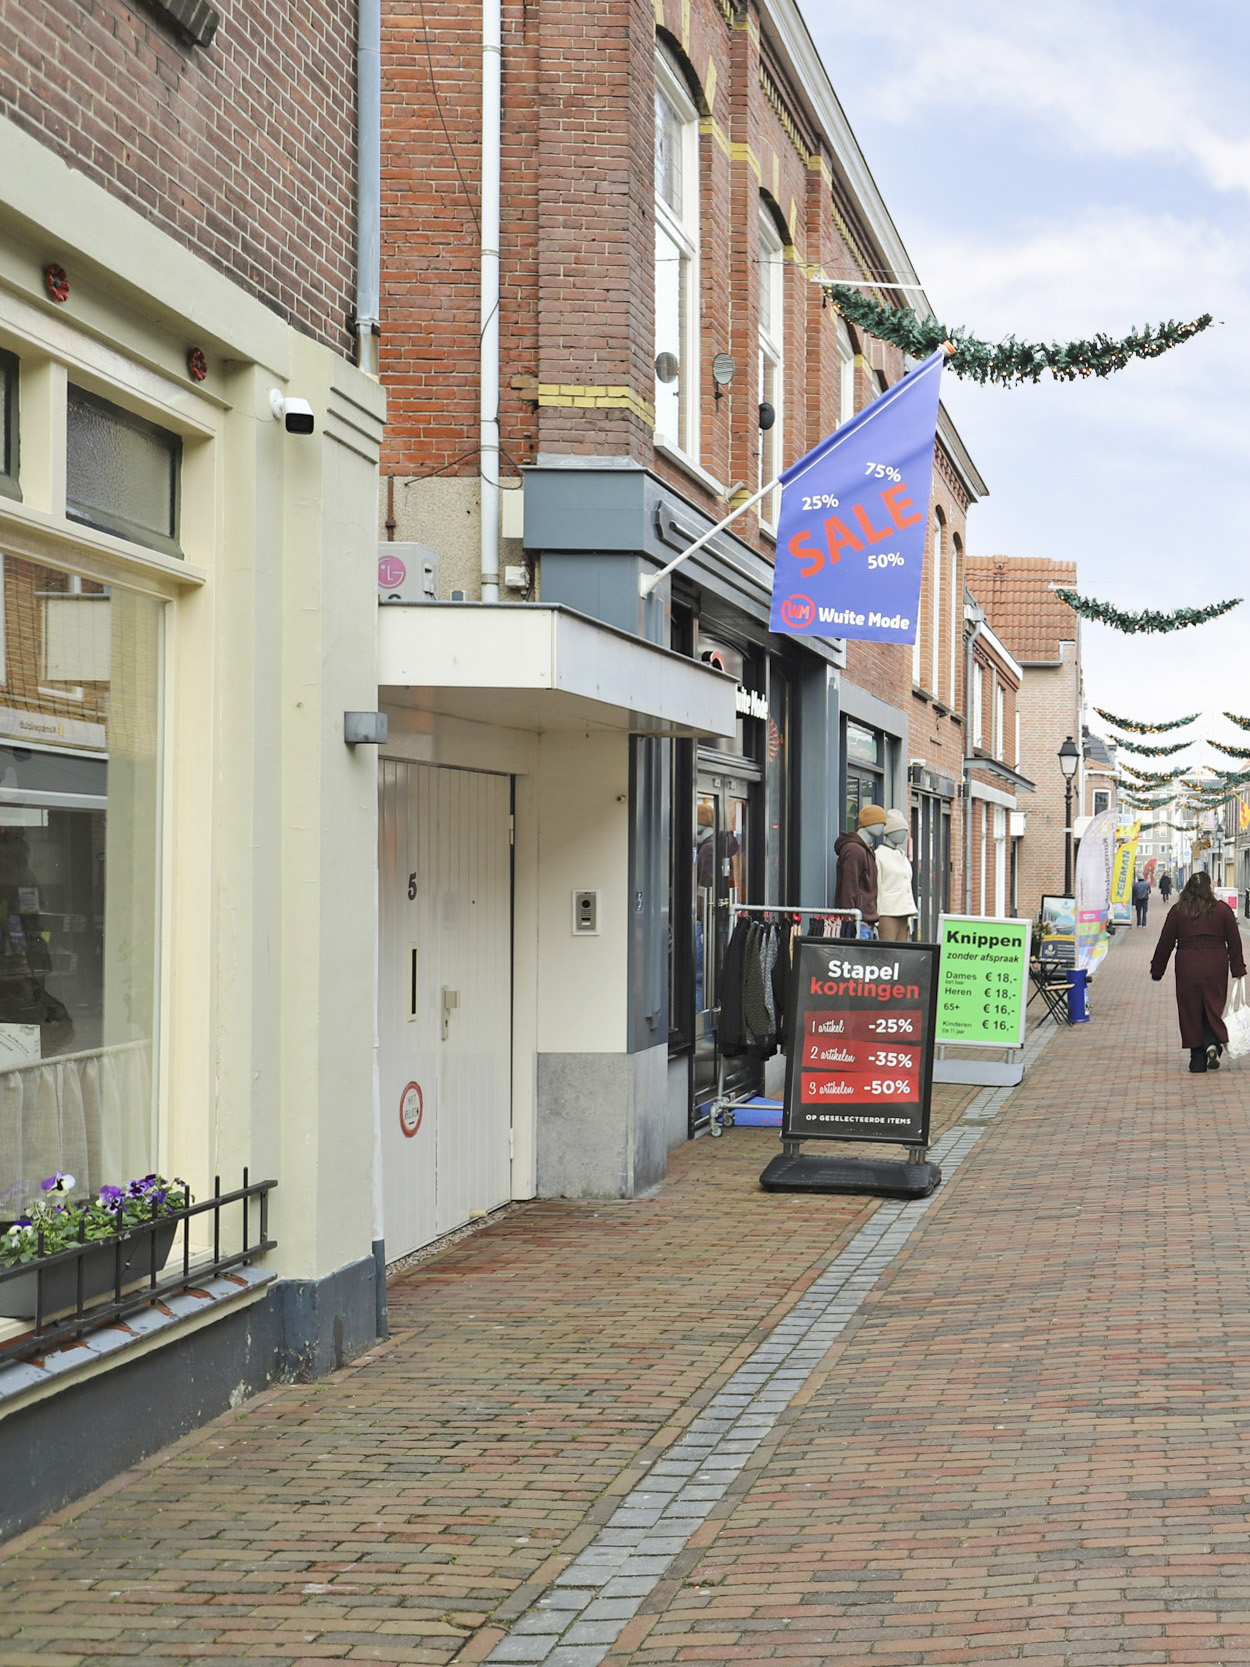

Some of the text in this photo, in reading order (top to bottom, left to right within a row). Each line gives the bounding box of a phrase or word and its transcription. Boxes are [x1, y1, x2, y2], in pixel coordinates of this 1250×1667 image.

[864, 462, 902, 483] 75%
[801, 493, 839, 511] 25%
[788, 482, 923, 578] SALE
[867, 552, 904, 569] 50%
[818, 607, 910, 630] Wuite Mode
[735, 683, 768, 720] uite Mode
[1116, 850, 1131, 898] ZEEMAN
[407, 872, 417, 901] 5
[947, 930, 1022, 949] Knippen
[947, 952, 1019, 964] zonder afspraak
[828, 960, 899, 982] Stapel
[946, 971, 1018, 984] Dames € 18,-
[810, 977, 919, 1001] kortingen
[944, 987, 1016, 1000] Heren € 18,-
[943, 1003, 1015, 1016] 65+ € 16,-
[811, 1019, 913, 1034] 1 artikel -25%
[982, 1020, 989, 1030] €
[993, 1021, 1014, 1032] 16,-
[810, 1047, 912, 1068] 2 artikelen -35%
[808, 1080, 911, 1095] 3 artikelen -50%
[805, 1114, 911, 1125] OP GESELECTEERDE ITEMS
